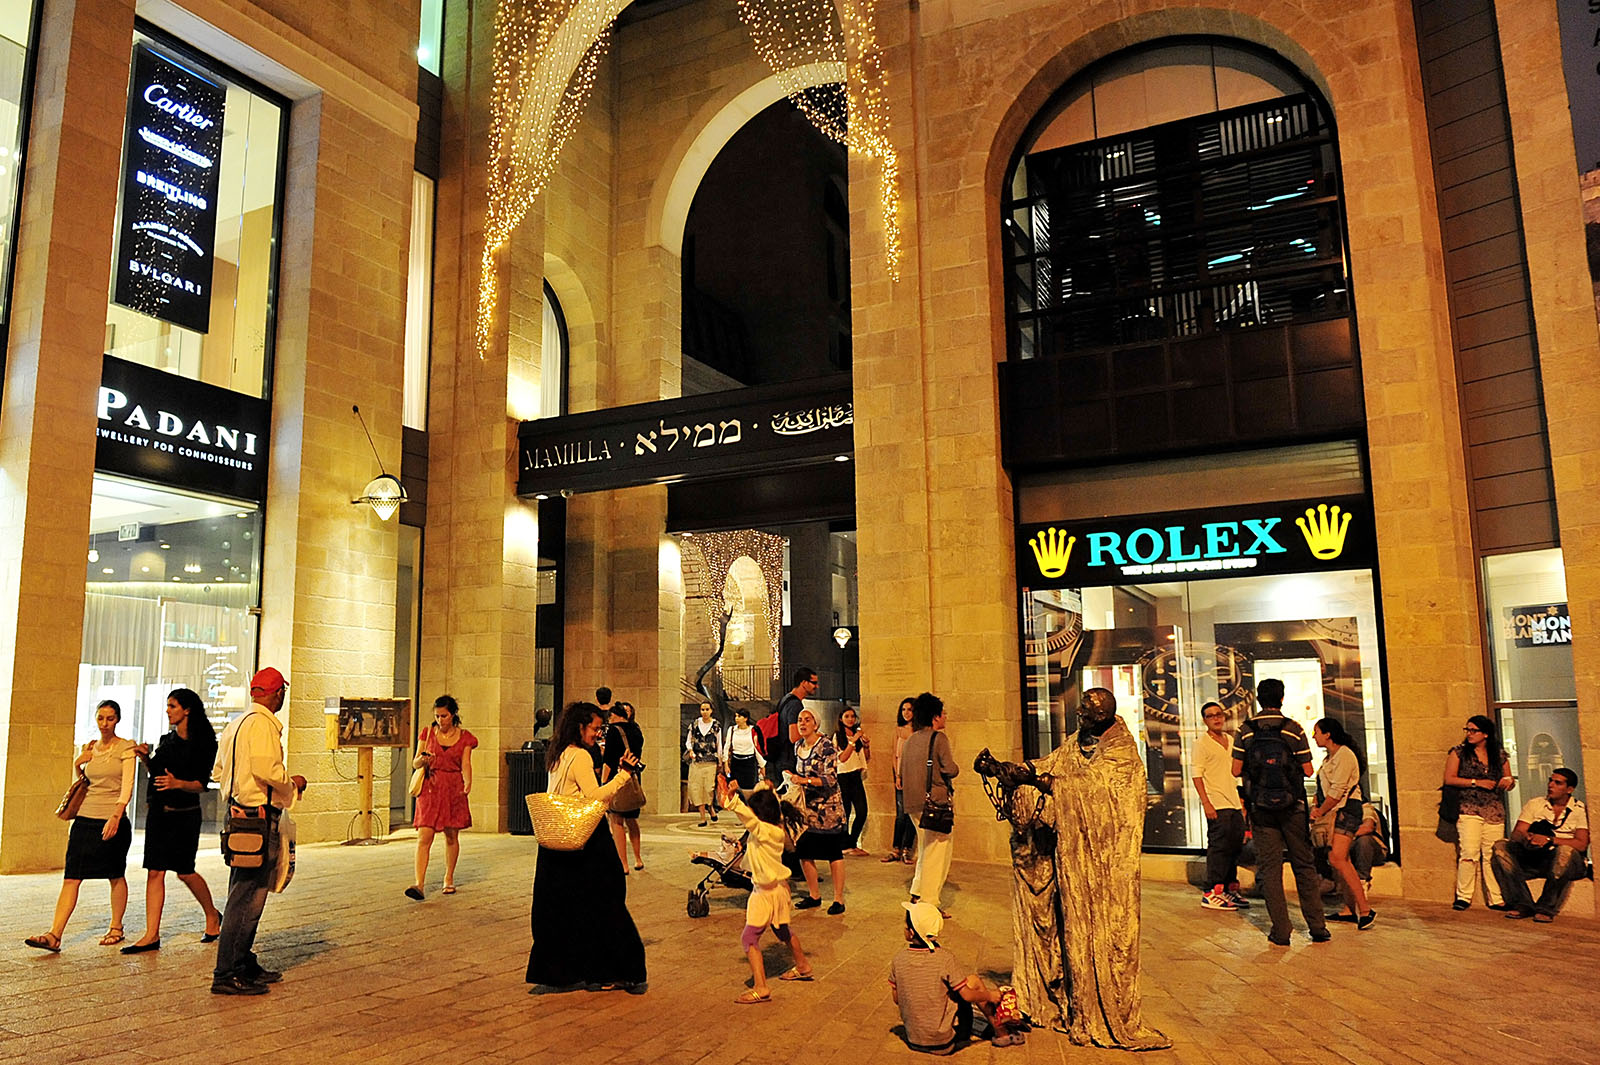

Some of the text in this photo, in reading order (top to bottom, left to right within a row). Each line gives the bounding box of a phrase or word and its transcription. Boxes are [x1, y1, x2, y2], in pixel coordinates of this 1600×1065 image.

[144, 84, 214, 130] Cartier
[136, 170, 207, 211] BREITLING
[129, 259, 202, 295] BVLGARI
[97, 386, 257, 455] PADANI
[635, 419, 742, 456] ממילא
[96, 427, 253, 471] EWELLERY FOR CONNOISSEURS
[524, 440, 612, 470] MAMILLA
[1086, 517, 1288, 567] ROLEX
[1531, 616, 1571, 631] MON
[1532, 630, 1573, 644] BLAN
